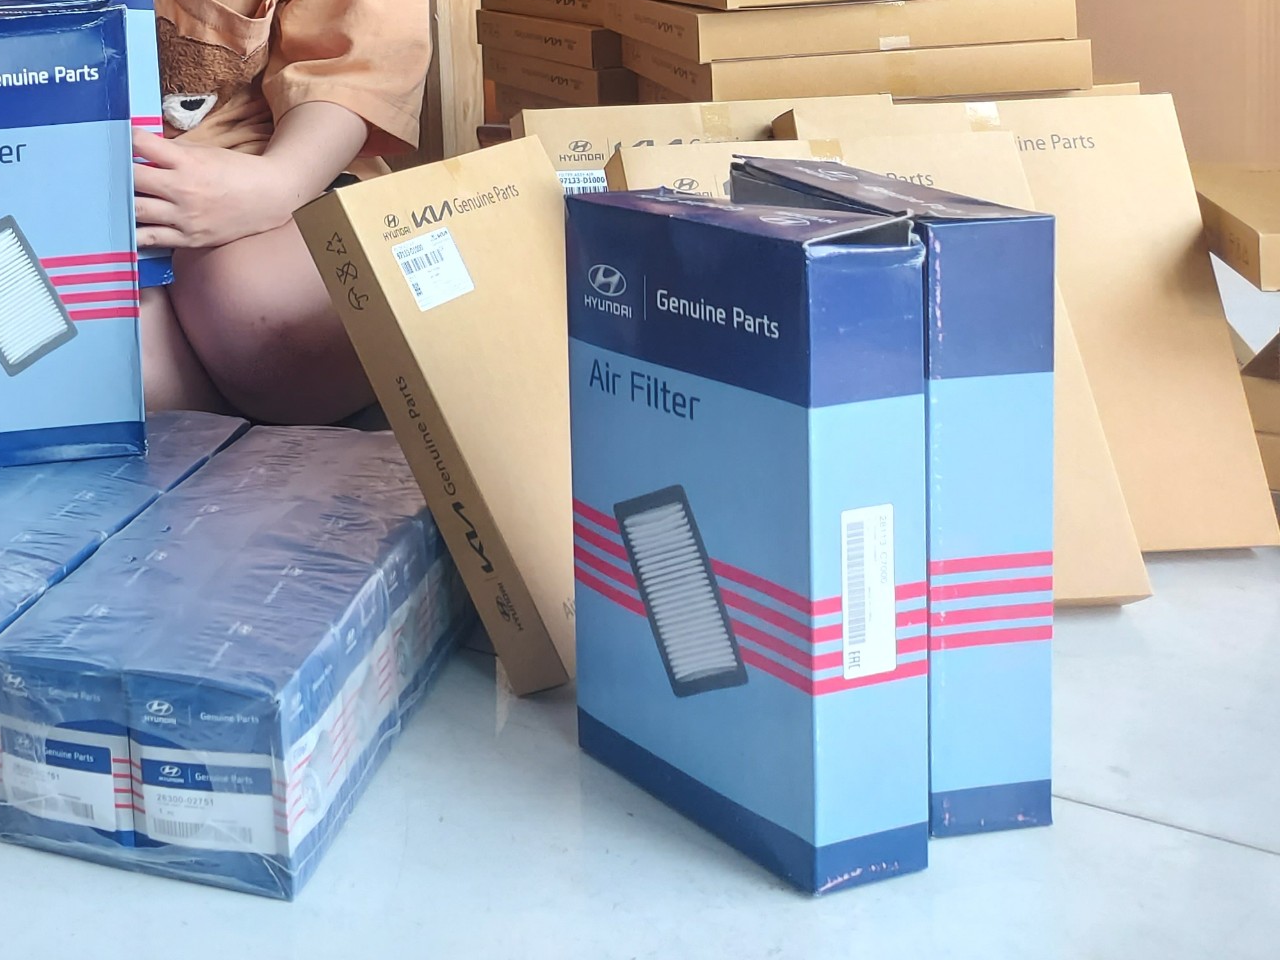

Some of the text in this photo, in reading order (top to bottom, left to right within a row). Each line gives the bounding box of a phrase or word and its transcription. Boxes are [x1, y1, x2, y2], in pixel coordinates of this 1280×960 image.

[54, 64, 99, 83] Parts
[1051, 134, 1095, 151] Parts
[559, 153, 605, 162] HYUNDAI
[559, 177, 605, 185] 97133-D1000
[383, 184, 519, 241] HYUNDAI KIA Genuine Parts
[584, 289, 780, 339] HYUNDAI Genuine Parts
[396, 375, 420, 420] Parts
[589, 358, 701, 421] Air Filter
[417, 421, 456, 496] Genuine
[452, 501, 494, 574] KIA
[200, 711, 235, 723] Genuine
[236, 713, 259, 724] Parts
[44, 746, 94, 763] Genuine Parts
[195, 772, 230, 783] Genuine
[231, 773, 253, 785] Parts
